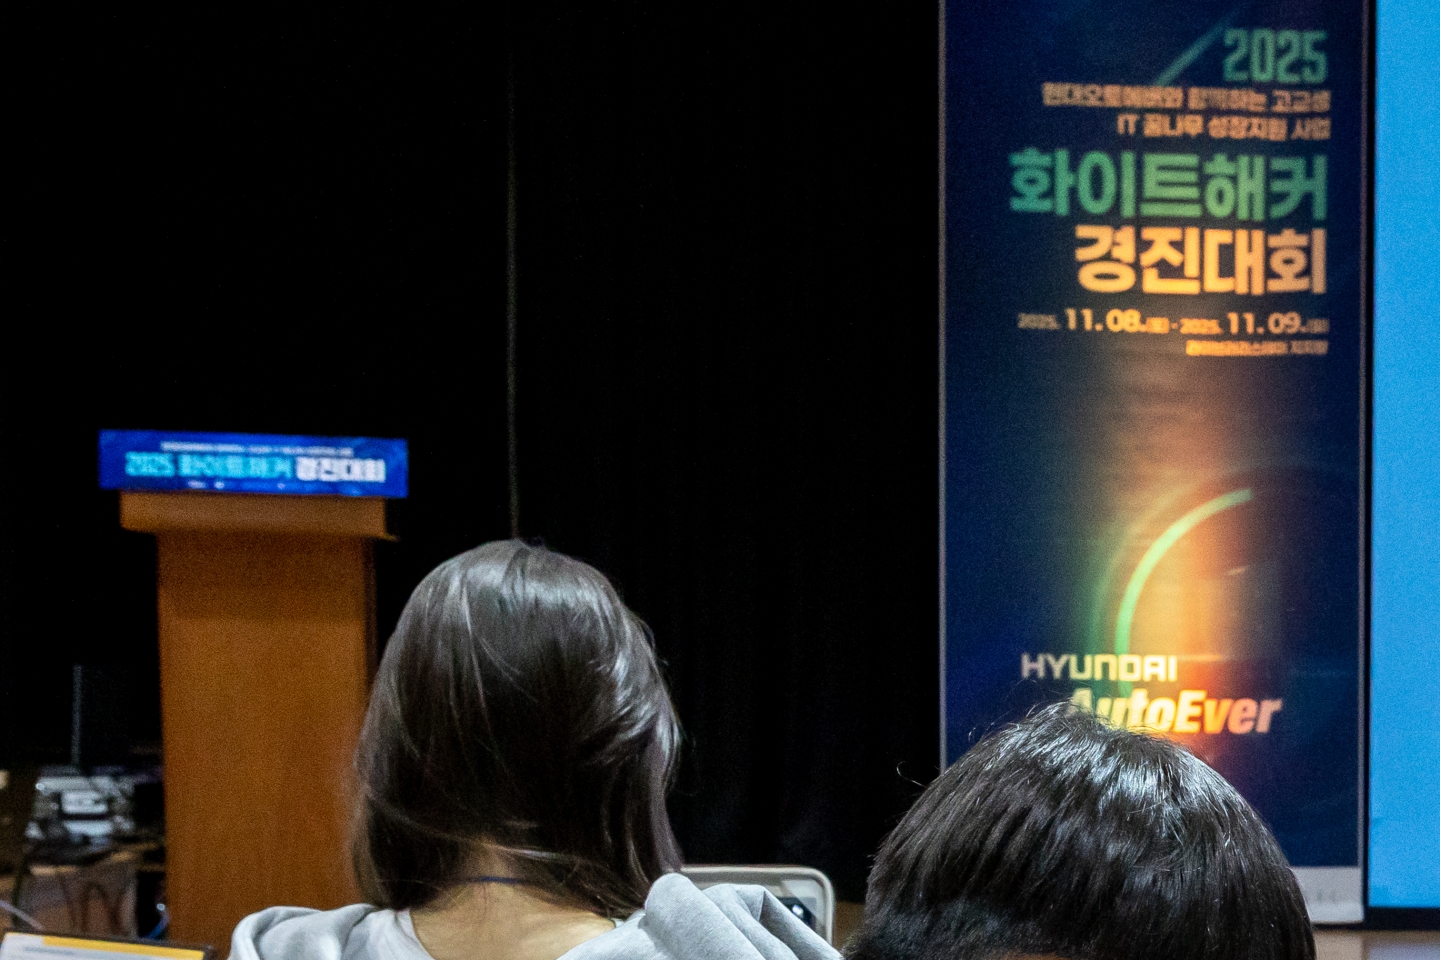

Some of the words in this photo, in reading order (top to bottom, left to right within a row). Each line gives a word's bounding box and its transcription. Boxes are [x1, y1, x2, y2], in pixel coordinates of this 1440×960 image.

[1223, 28, 1328, 83] 2025
[1117, 113, 1139, 135] IT
[1009, 146, 1328, 221] 화이트해커
[1075, 224, 1327, 295] 경진대회
[1020, 652, 1178, 681] HYUNDAI
